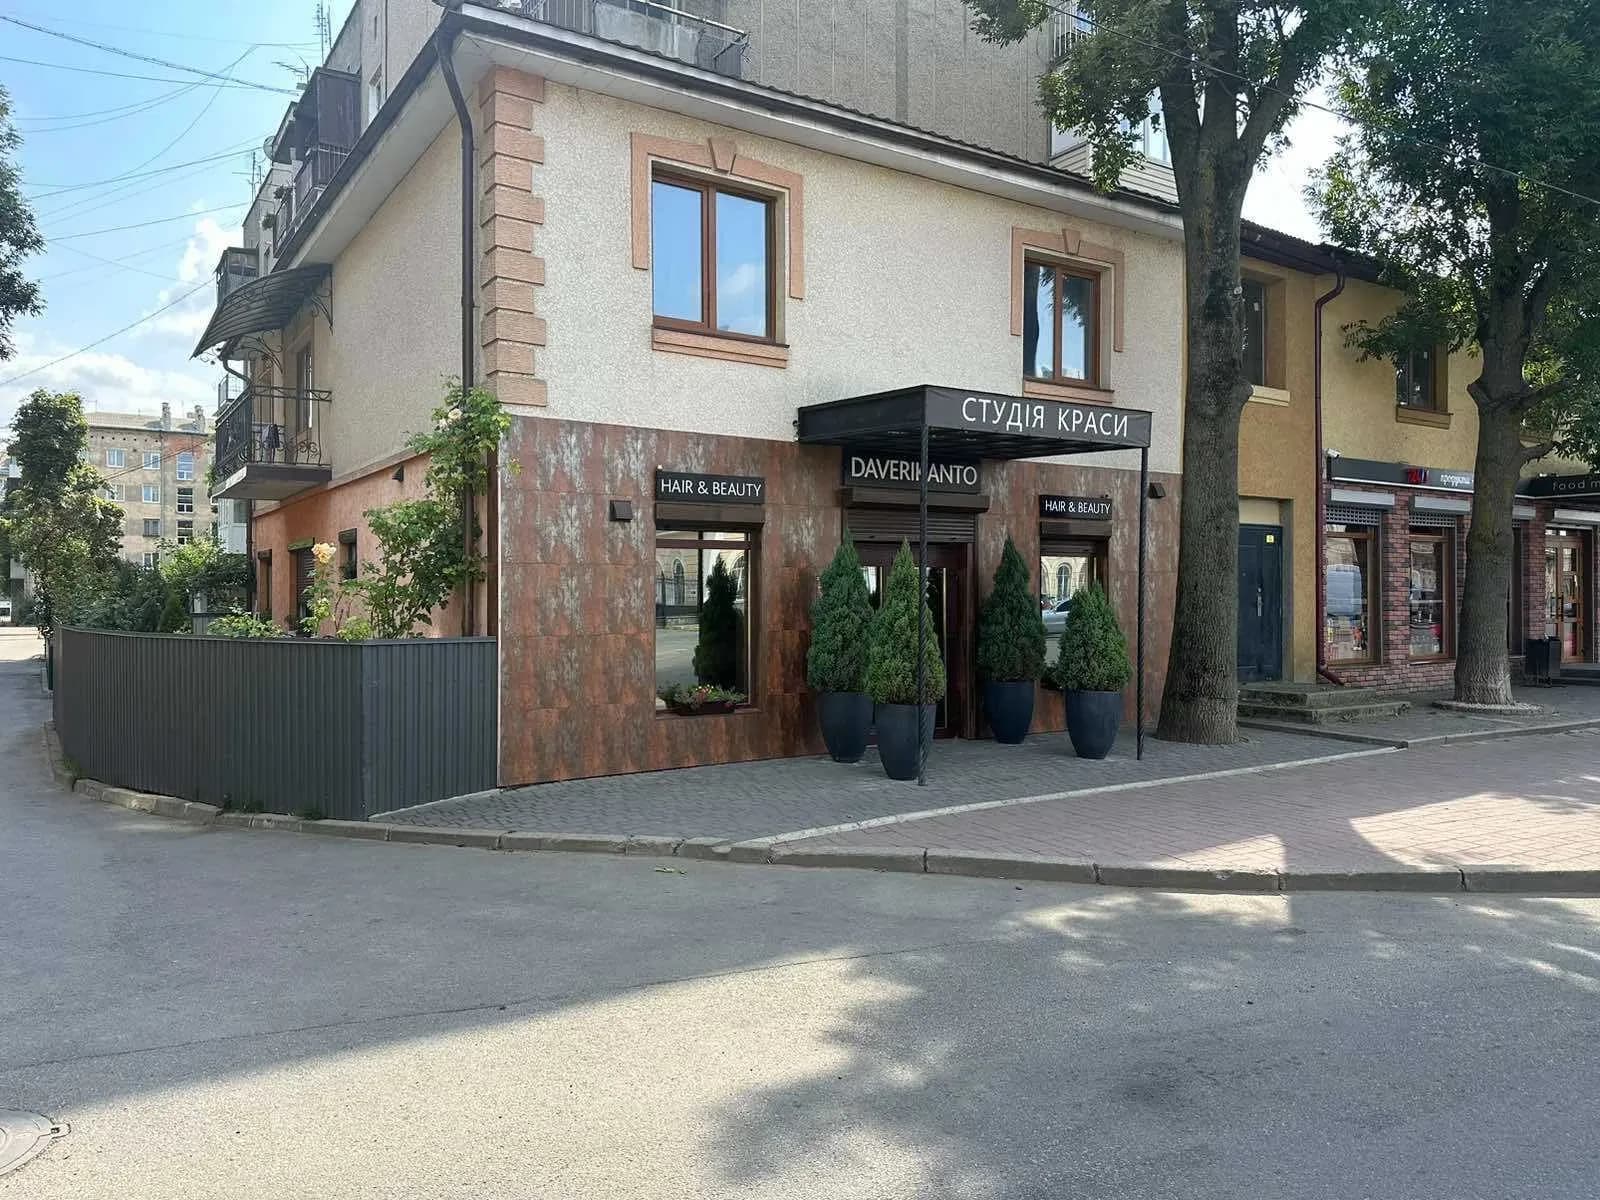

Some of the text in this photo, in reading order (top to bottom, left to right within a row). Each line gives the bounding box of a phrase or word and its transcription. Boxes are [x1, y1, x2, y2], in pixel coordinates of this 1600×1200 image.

[962, 397, 1128, 437] СТУДІЯ КРАСИ
[661, 479, 762, 497] HAIR & BEAUTY
[1552, 480, 1585, 491] food
[1045, 500, 1111, 514] HAIR & BEAUTY
